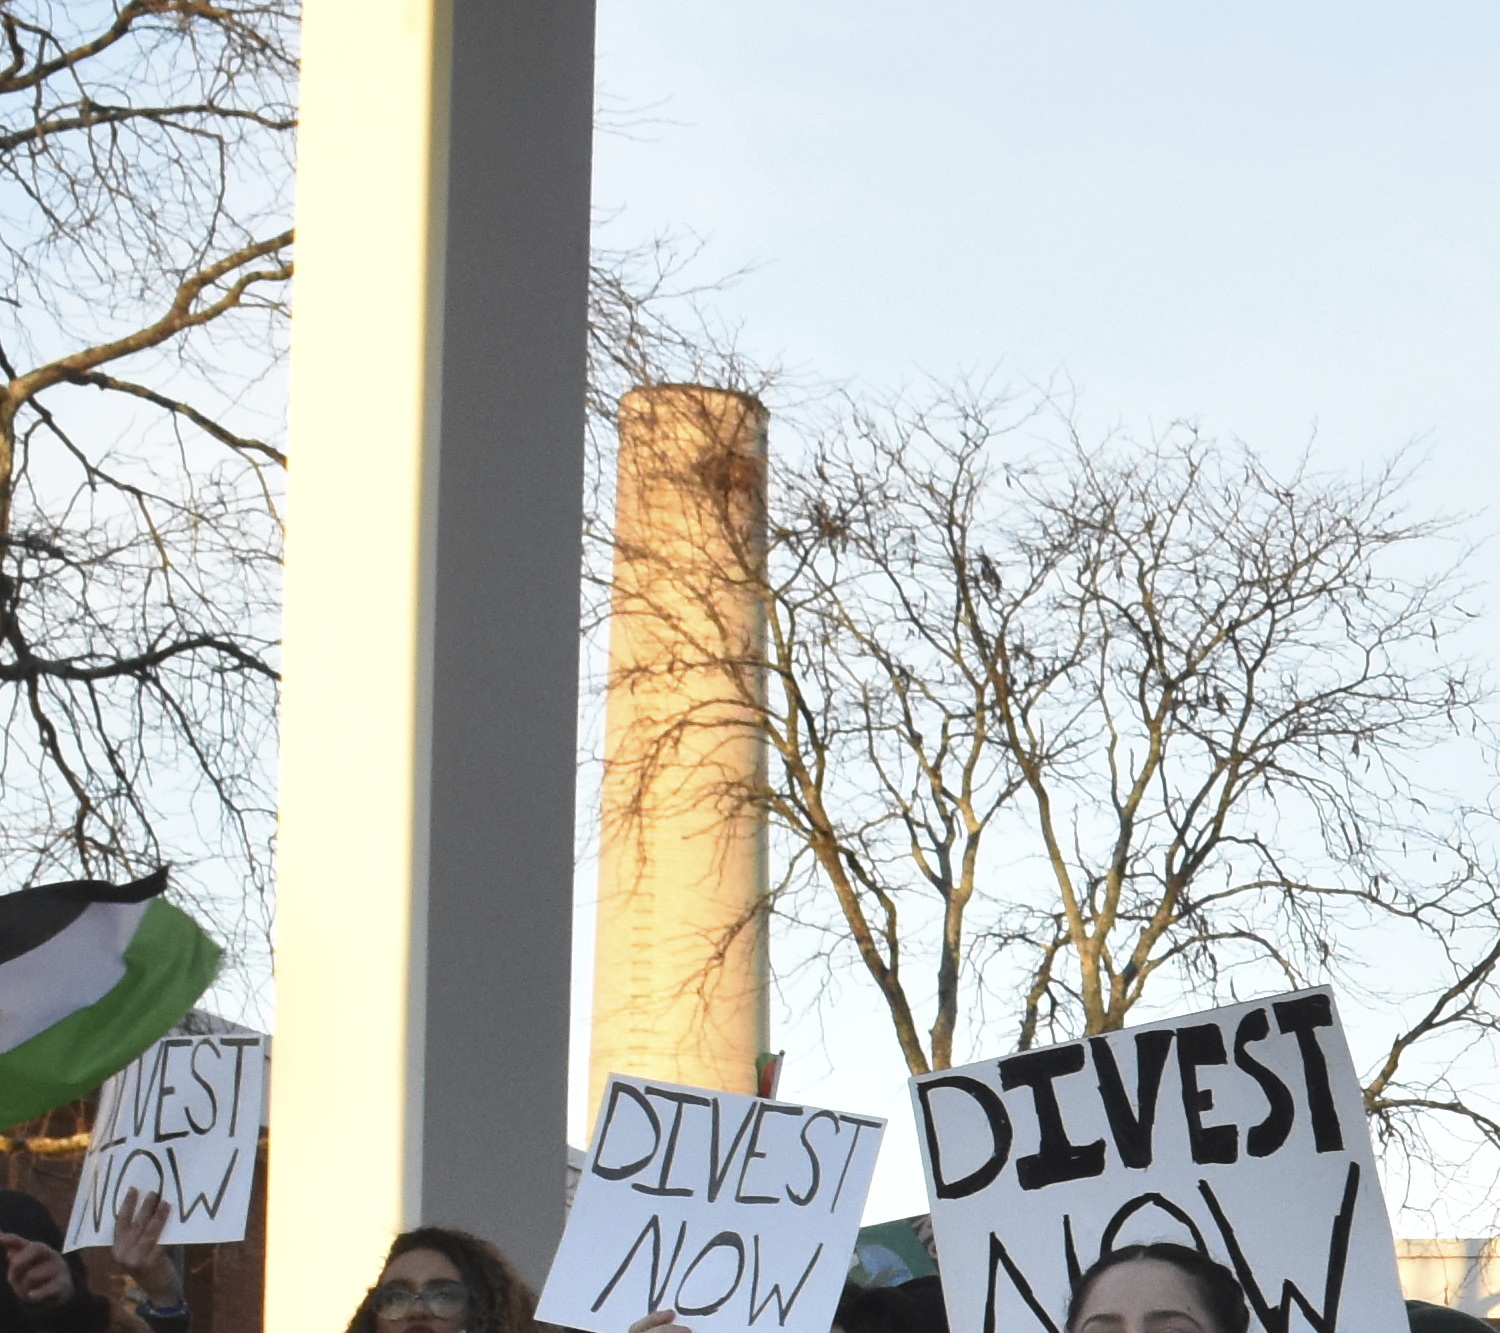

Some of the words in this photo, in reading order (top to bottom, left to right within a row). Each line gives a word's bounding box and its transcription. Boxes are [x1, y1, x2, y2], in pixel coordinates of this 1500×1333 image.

[88, 1037, 260, 1157] IVEST
[590, 1081, 882, 1214] DIVEST
[917, 993, 1345, 1200] DIVEST
[74, 1148, 240, 1245] NOW
[590, 1214, 824, 1329] NOW
